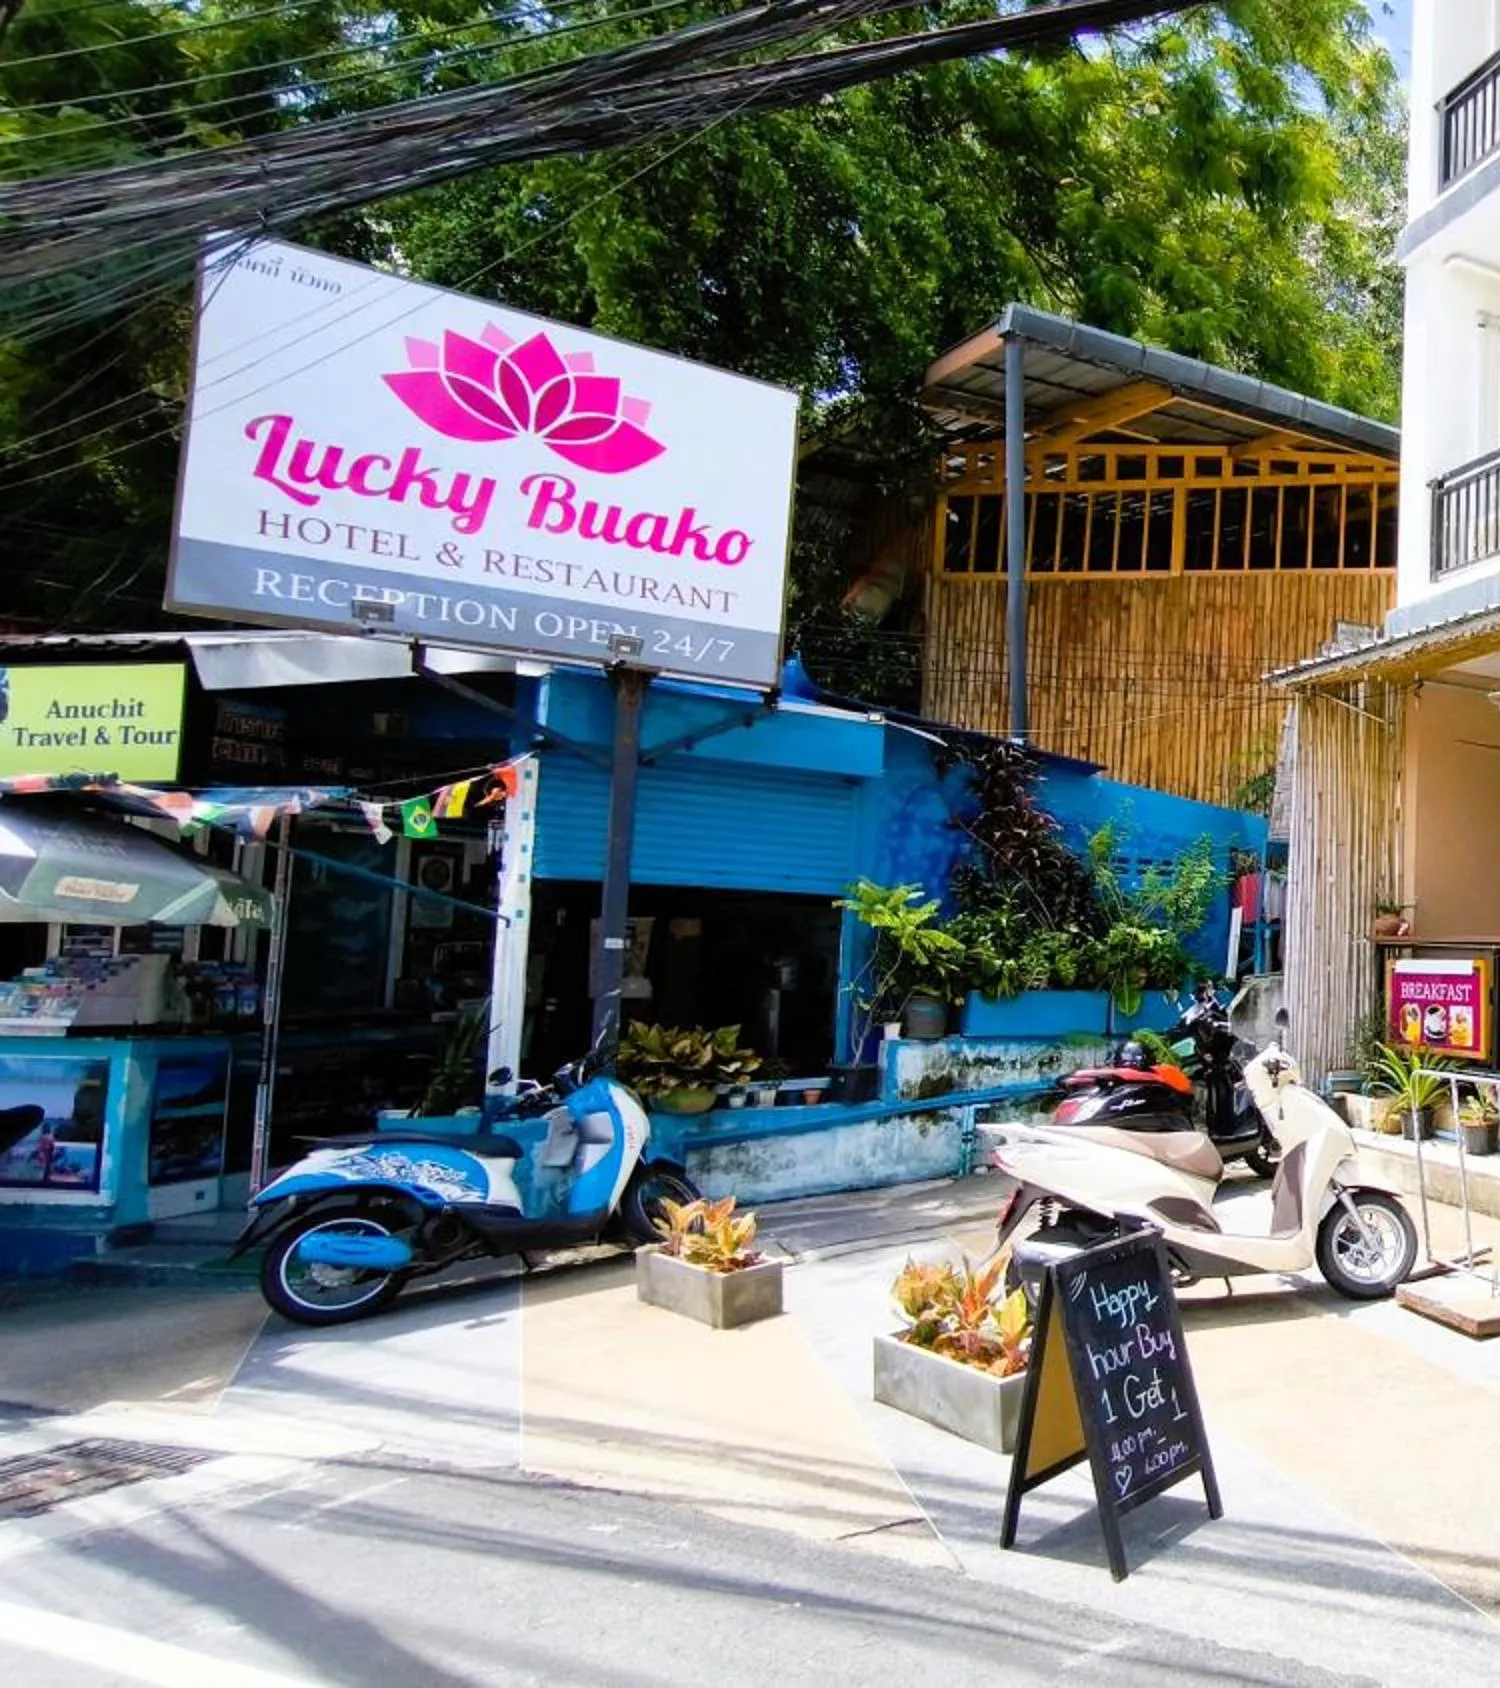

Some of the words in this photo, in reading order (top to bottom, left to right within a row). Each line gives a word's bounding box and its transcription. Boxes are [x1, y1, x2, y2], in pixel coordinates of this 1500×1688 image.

[244, 413, 497, 536] Lucky
[519, 472, 755, 566] Buako
[257, 509, 421, 561] HOTEL
[435, 541, 463, 568] &
[483, 549, 738, 614] RESTAURANT
[254, 568, 518, 632] RECEPTION
[652, 629, 735, 662] 24/7
[12, 726, 87, 747] Travel
[94, 726, 111, 746] &
[119, 725, 177, 746] Tour
[45, 698, 145, 719] Anuchit
[1400, 982, 1473, 1003] BREAKFAST
[1089, 1280, 1159, 1328] Happy
[1086, 1340, 1134, 1380] hour
[1136, 1323, 1176, 1360] Buy
[1101, 1388, 1118, 1423] 1
[1124, 1367, 1165, 1419] Get
[1171, 1386, 1188, 1421] 1
